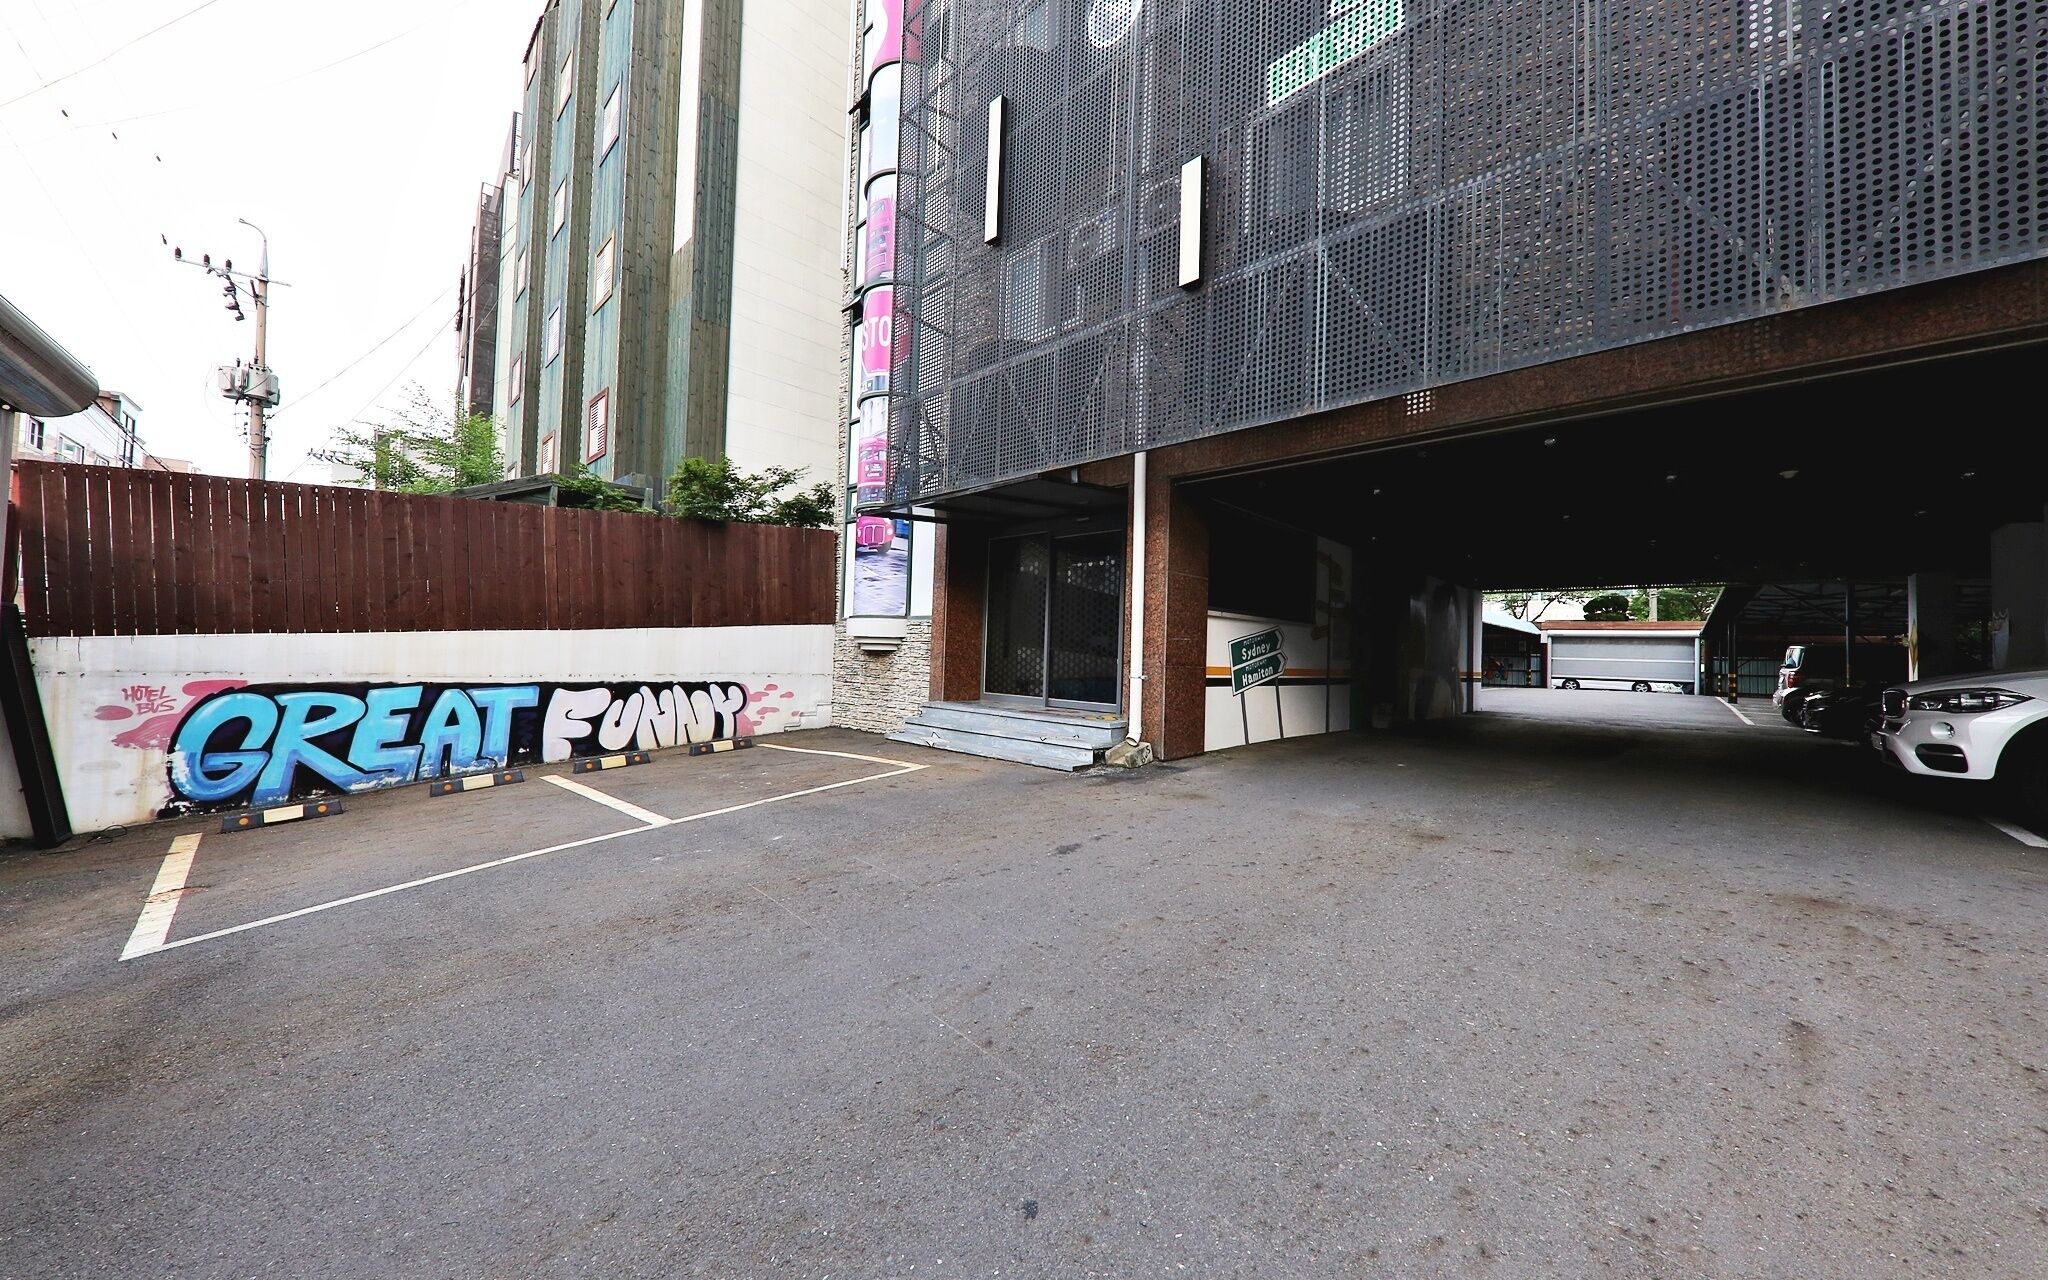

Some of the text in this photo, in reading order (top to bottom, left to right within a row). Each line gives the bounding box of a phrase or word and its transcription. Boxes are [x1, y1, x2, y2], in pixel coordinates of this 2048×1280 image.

[1241, 643, 1271, 660] Sydney
[1242, 666, 1273, 686] Hamiton
[122, 685, 170, 701] HOTEL
[136, 699, 177, 715] BUS
[172, 684, 744, 810] GREAT FUNNY
